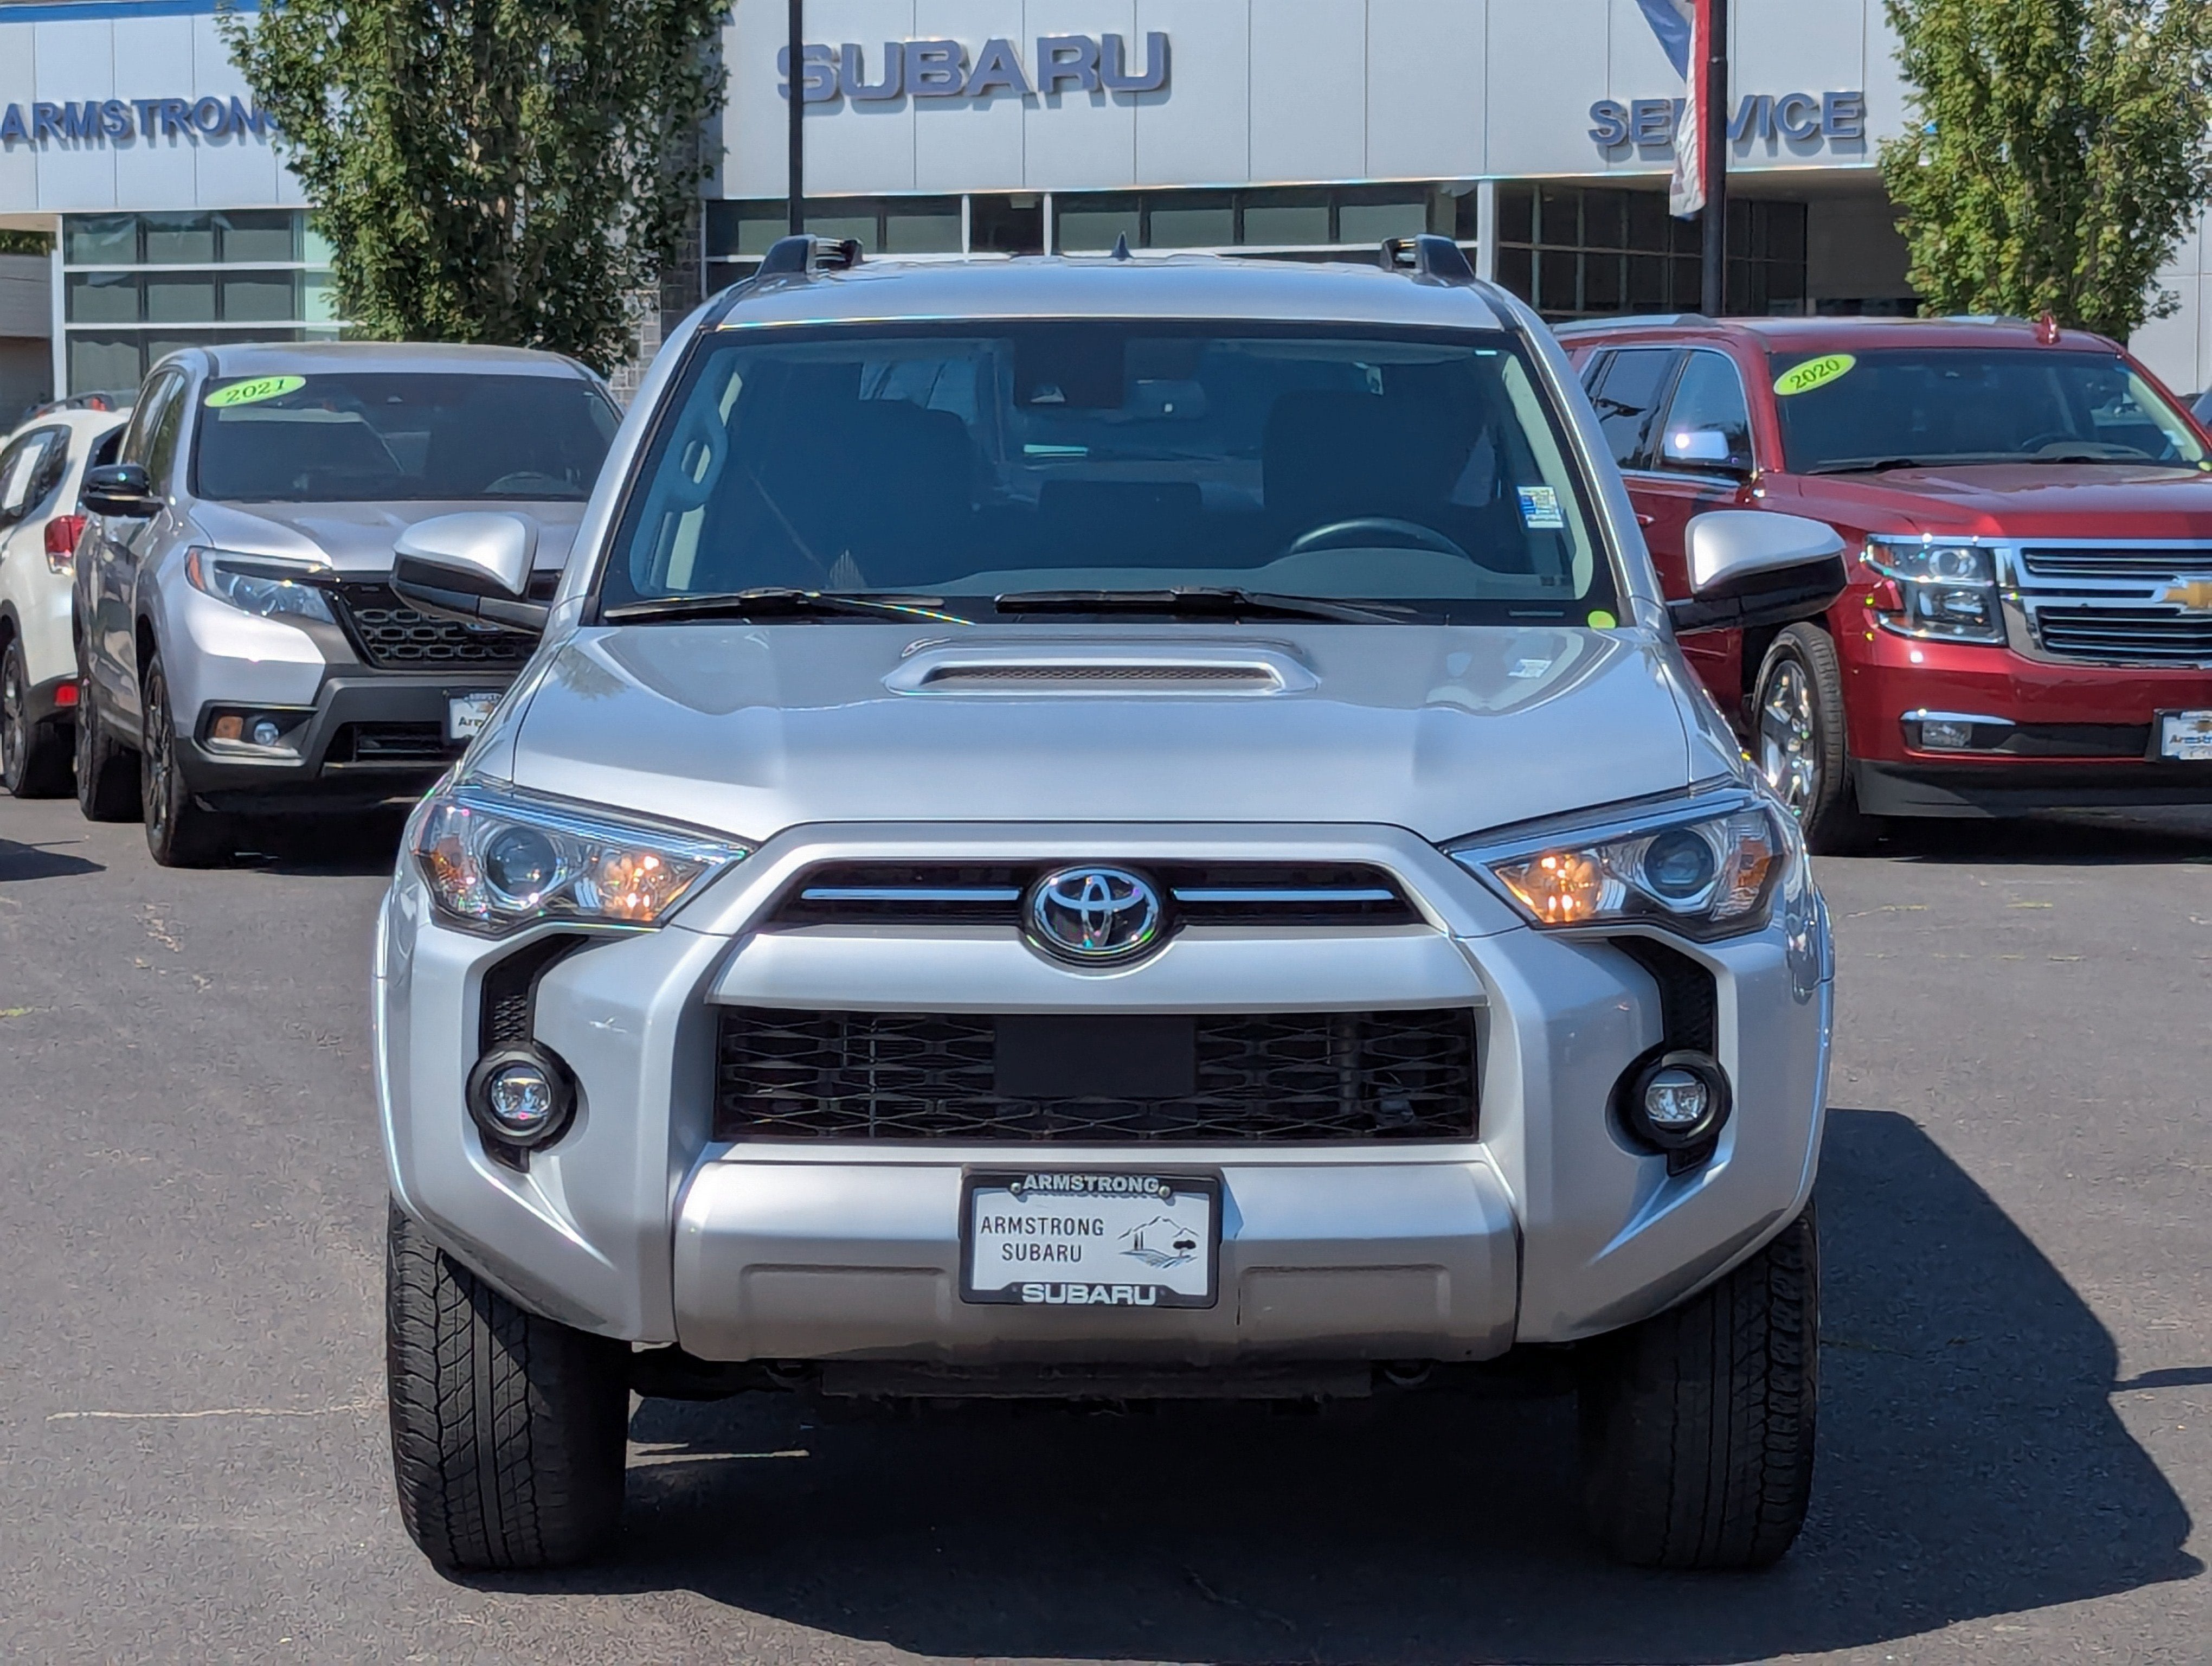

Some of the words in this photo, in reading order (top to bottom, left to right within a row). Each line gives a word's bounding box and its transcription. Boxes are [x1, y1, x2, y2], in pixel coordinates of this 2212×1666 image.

[776, 31, 1168, 102] SUBARU
[1790, 358, 1840, 389] 2020
[226, 379, 285, 403] 2021
[1023, 1174, 1159, 1193] ARMSTRONG
[980, 1216, 1104, 1236] ARMSTRONG
[1002, 1242, 1082, 1263] SUBARU
[1022, 1283, 1156, 1306] SUBARU
